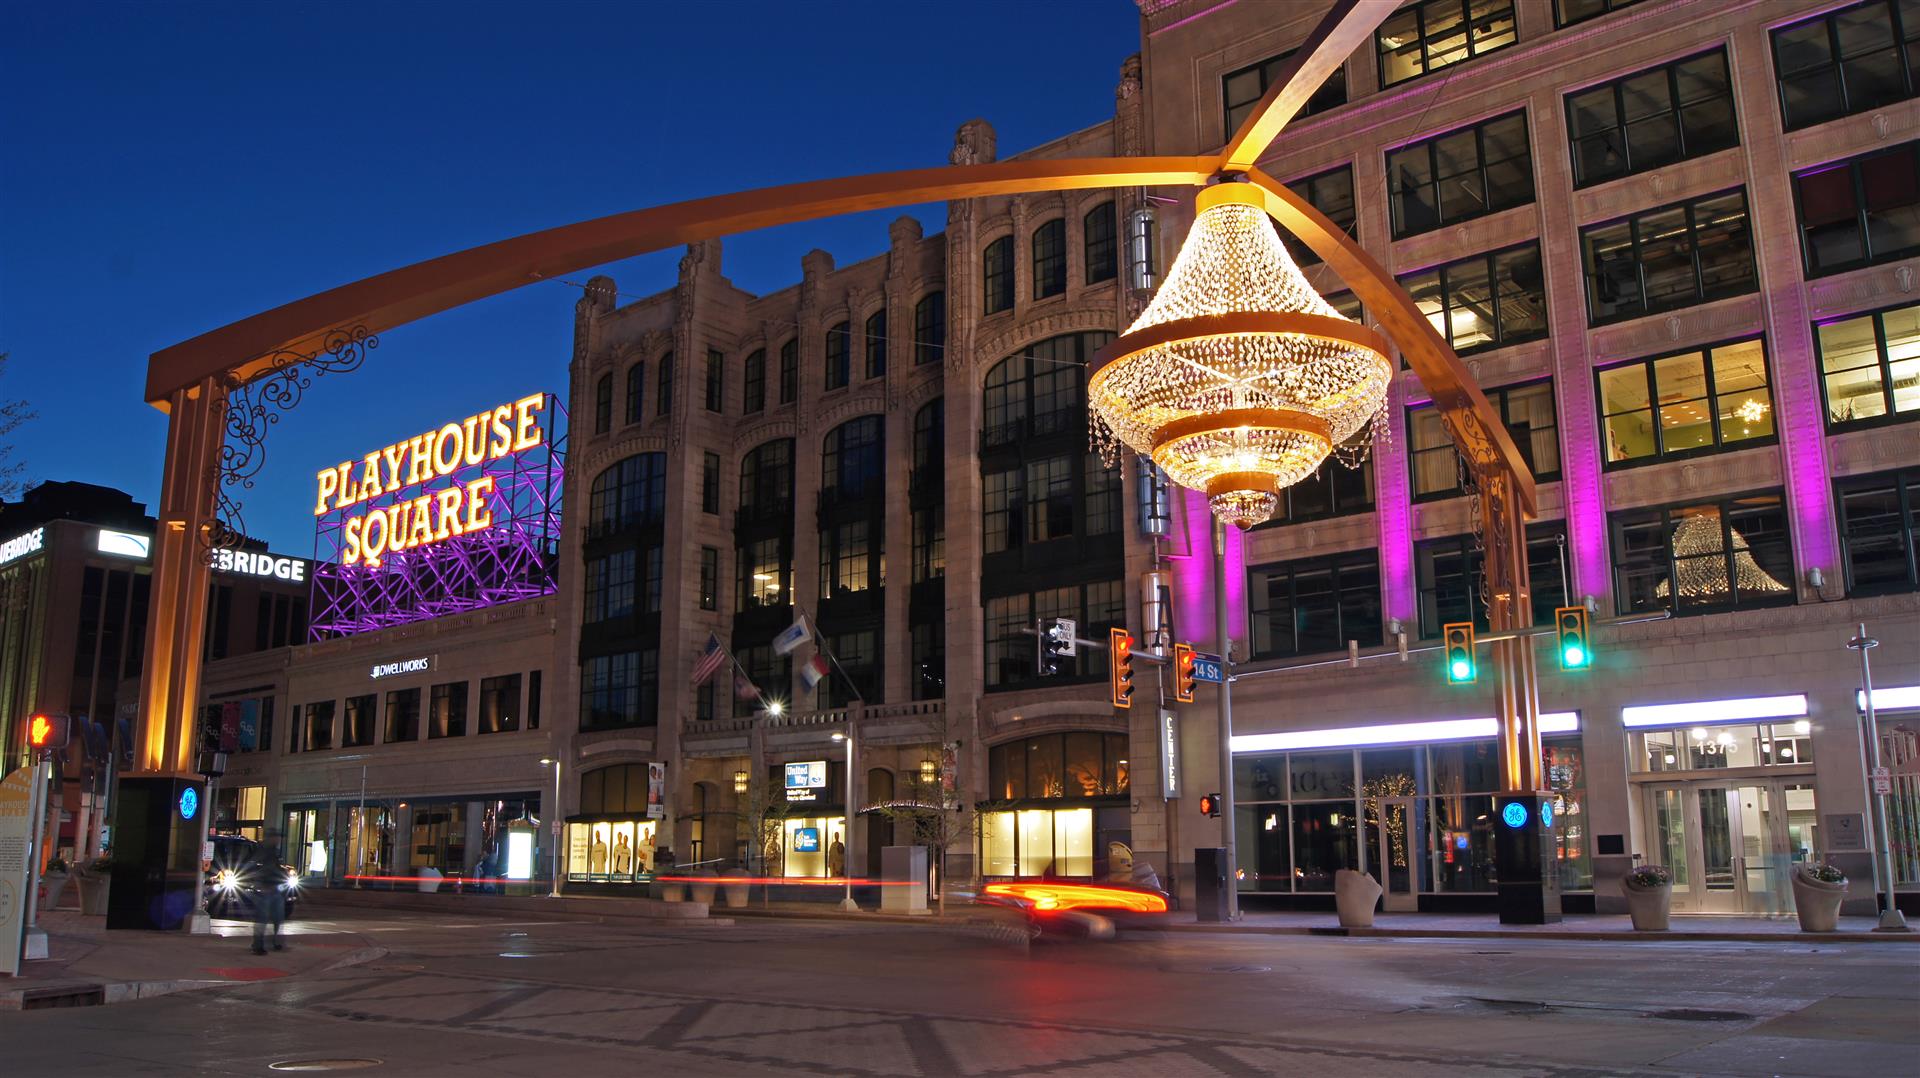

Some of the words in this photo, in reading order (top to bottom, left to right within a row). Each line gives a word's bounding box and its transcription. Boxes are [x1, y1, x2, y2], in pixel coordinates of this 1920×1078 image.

[314, 392, 545, 515] PLAYHOUSE
[343, 476, 493, 567] SQUARE
[1207, 664, 1218, 679] St
[1166, 716, 1176, 792] CENTER
[1696, 740, 1738, 755] 1375
[788, 766, 808, 775] United
[795, 775, 808, 785] Way
